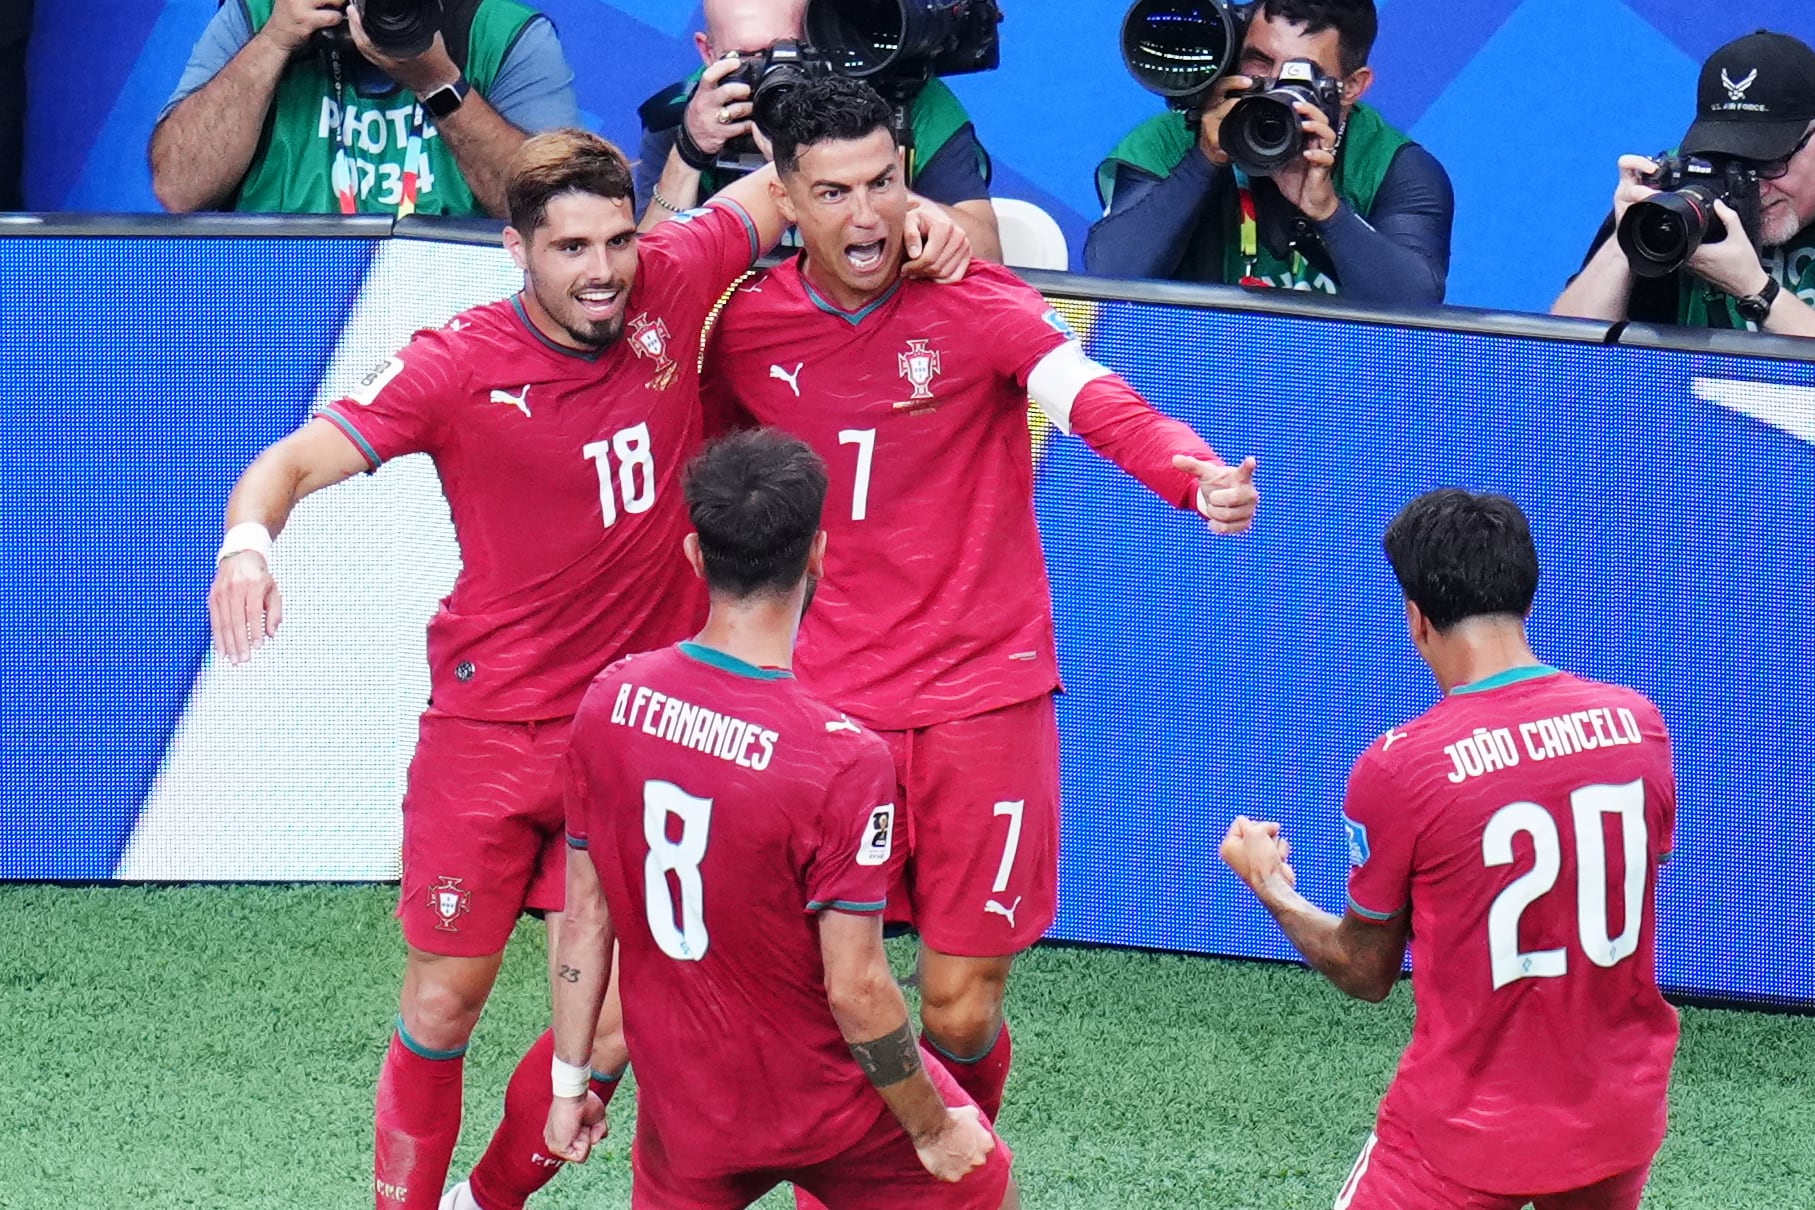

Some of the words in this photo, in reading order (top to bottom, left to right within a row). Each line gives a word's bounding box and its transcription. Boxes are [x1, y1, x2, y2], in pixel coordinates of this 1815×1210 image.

[582, 421, 655, 528] 18
[838, 428, 876, 520] 7
[1444, 727, 1520, 784] JOÃO
[1519, 707, 1642, 761] CANCELO
[643, 780, 714, 962] 8
[992, 799, 1024, 892] 7
[1482, 776, 1648, 992] 20
[558, 964, 581, 983] 23
